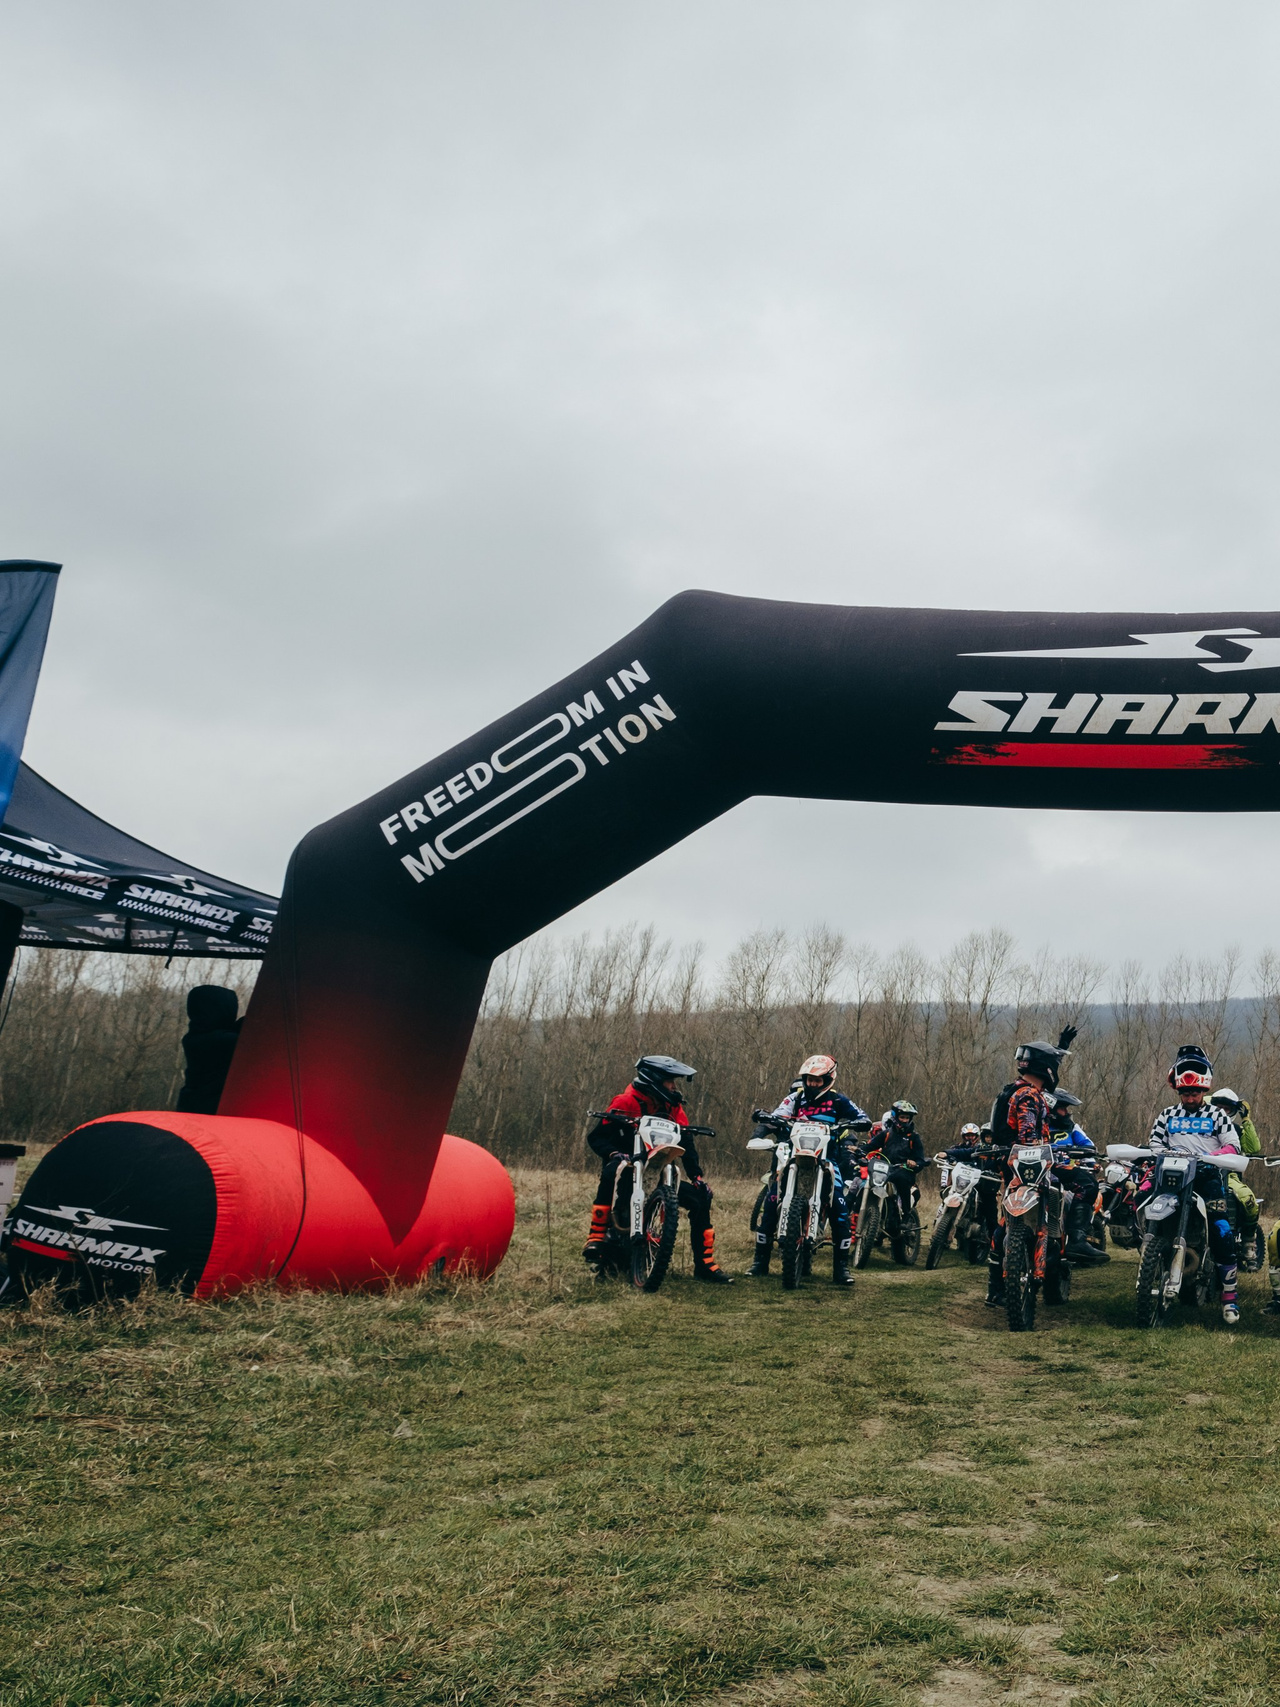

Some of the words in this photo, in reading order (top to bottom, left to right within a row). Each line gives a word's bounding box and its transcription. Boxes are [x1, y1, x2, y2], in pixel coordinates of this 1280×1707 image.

[379, 690, 605, 846] FREEDOM
[606, 659, 651, 701] IN
[400, 693, 677, 884] MOTION
[60, 882, 107, 901] RACE
[123, 883, 241, 924] SHARMAX
[192, 917, 231, 934] RACE
[13, 1218, 167, 1264] SHARMAX
[87, 1256, 154, 1276] MOTORS
